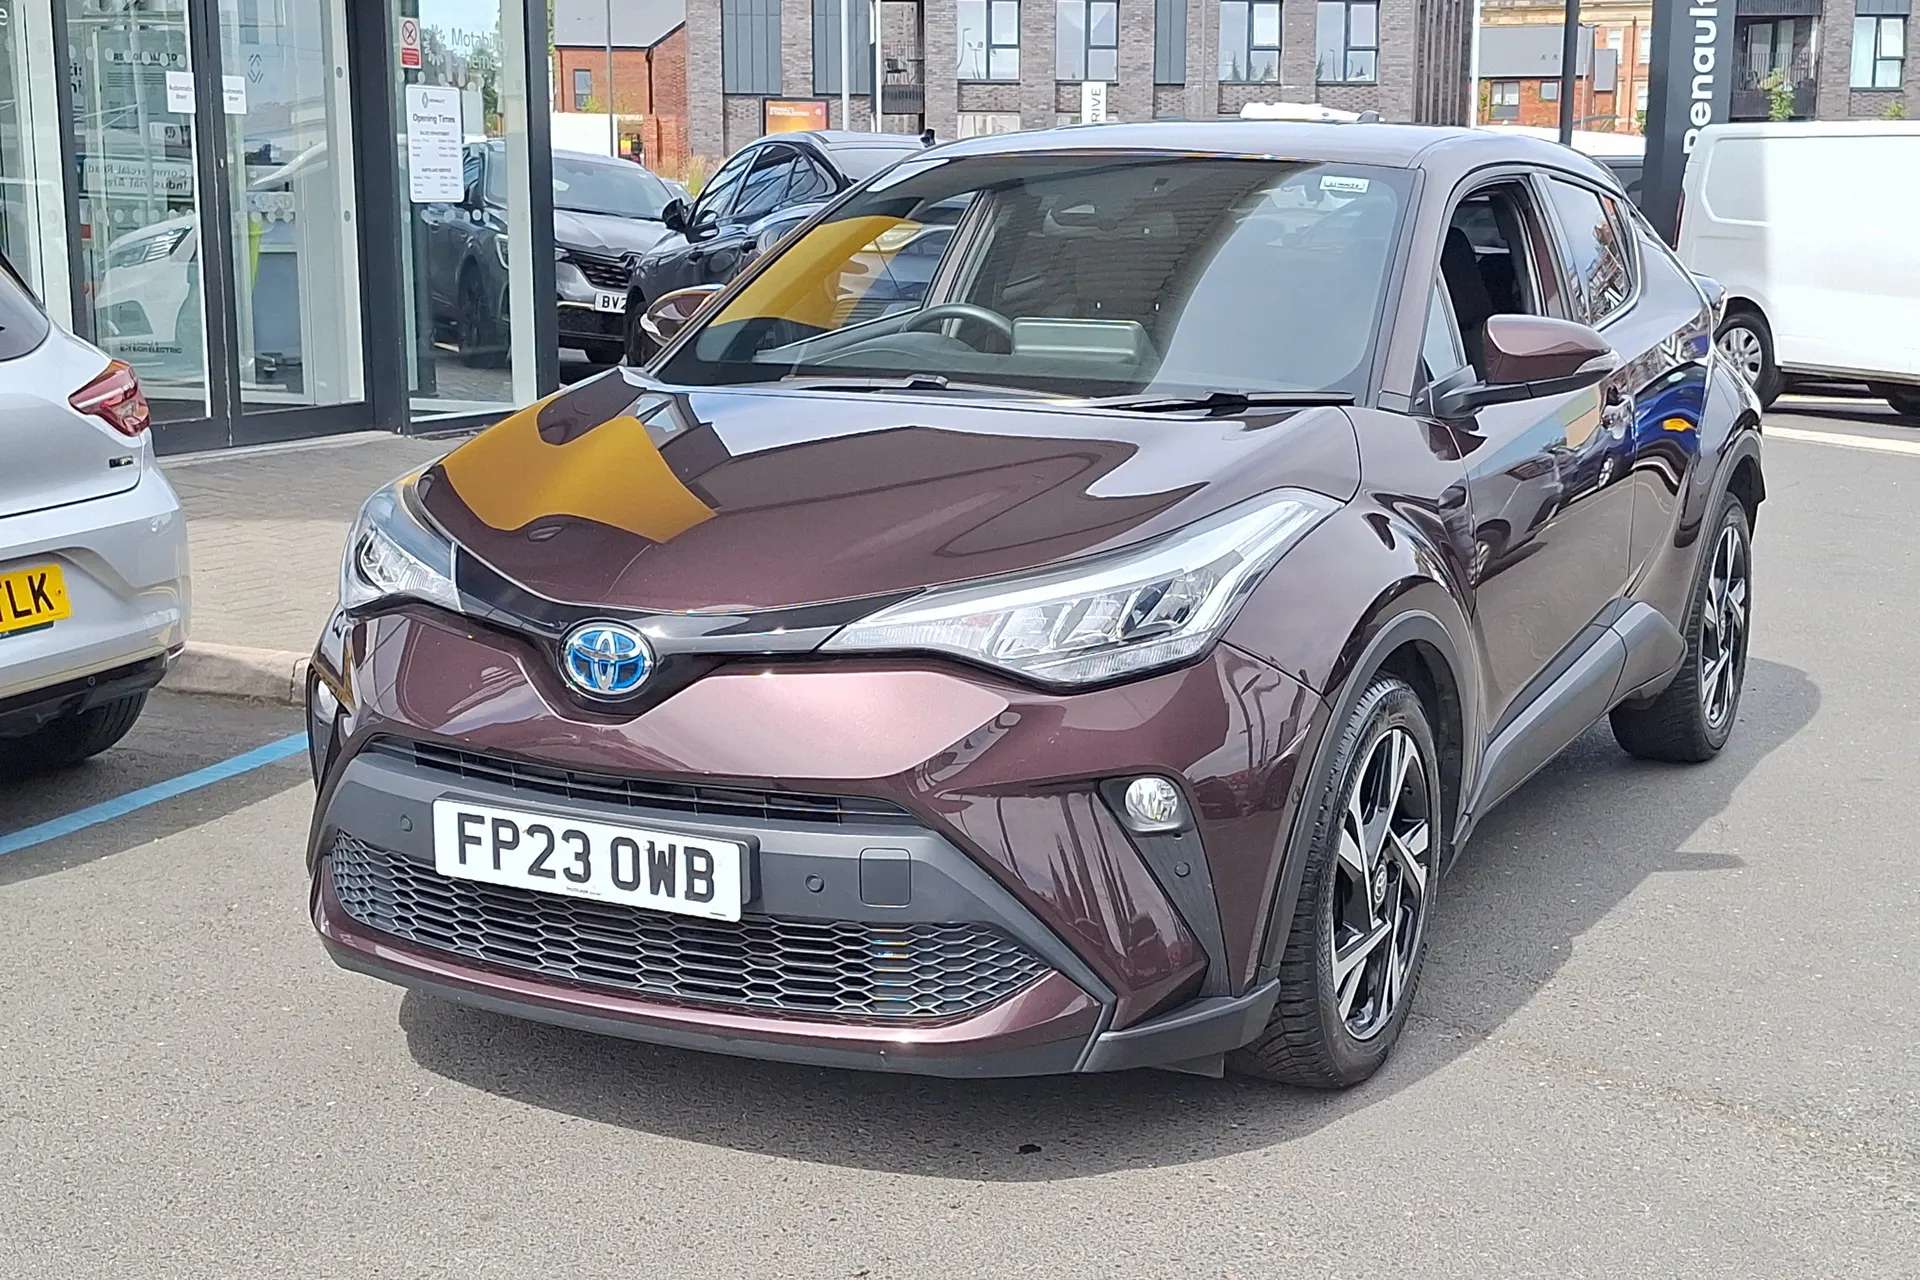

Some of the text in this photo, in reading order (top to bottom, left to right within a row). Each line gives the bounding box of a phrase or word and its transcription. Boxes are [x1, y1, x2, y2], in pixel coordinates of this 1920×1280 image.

[0, 572, 54, 622] LK
[456, 811, 715, 904] FP23 OWB
